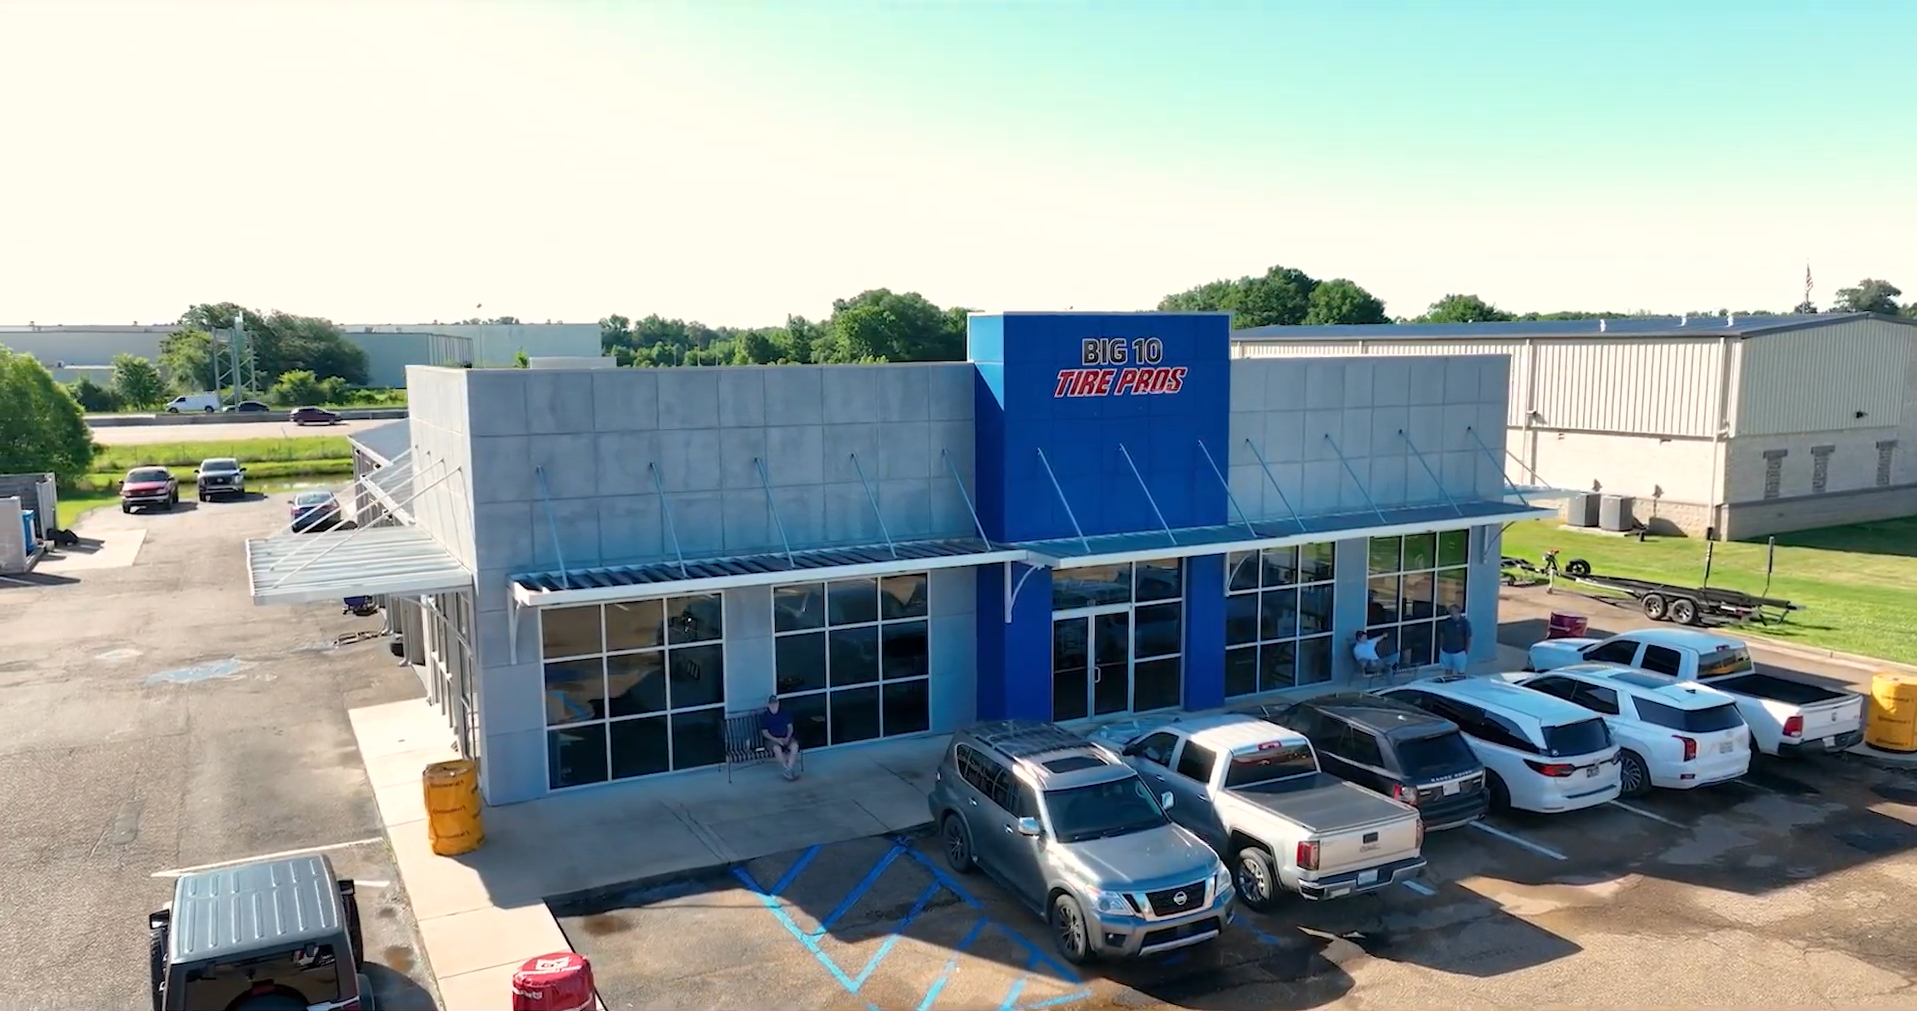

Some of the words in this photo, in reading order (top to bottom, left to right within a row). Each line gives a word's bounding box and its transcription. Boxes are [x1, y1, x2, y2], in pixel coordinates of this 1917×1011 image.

[1082, 338, 1127, 365] BIG
[1132, 337, 1163, 365] 10
[1054, 368, 1117, 397] TIRE
[1114, 367, 1188, 395] PROS
